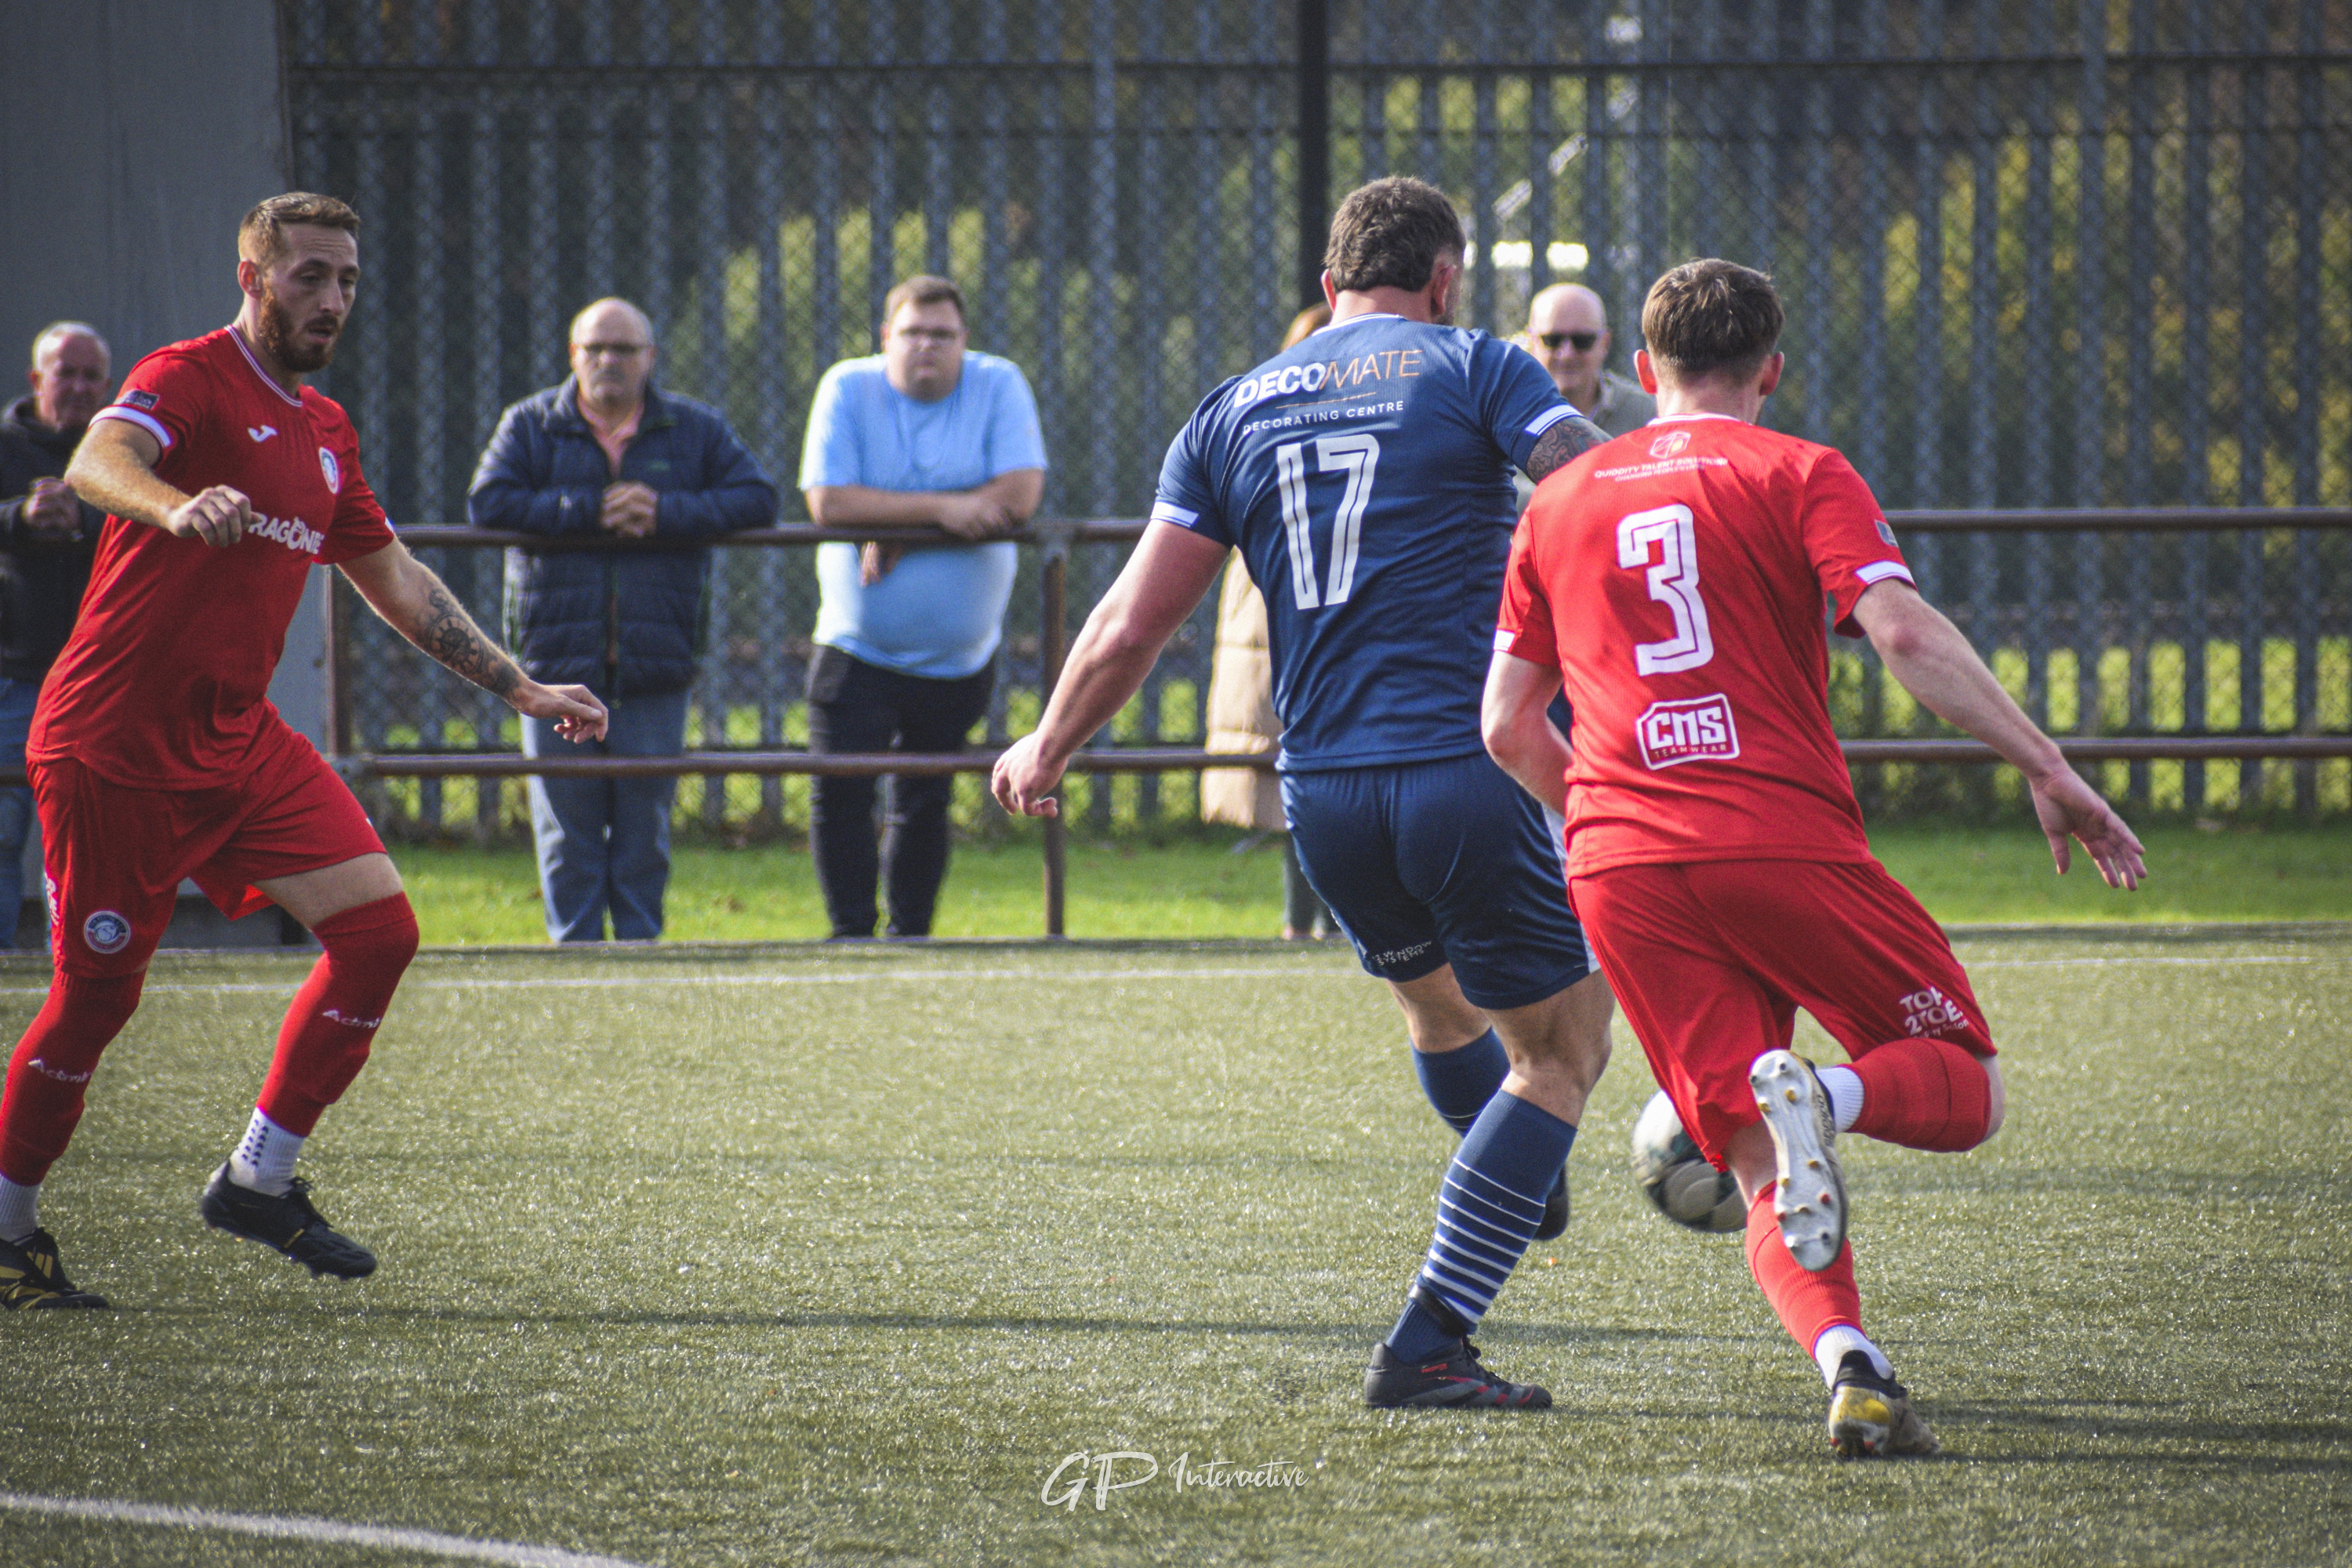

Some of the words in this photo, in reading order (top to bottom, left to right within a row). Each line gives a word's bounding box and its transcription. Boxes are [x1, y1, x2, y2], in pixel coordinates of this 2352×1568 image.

[1243, 410, 1339, 434] DECORATING
[1346, 401, 1404, 417] CENTRE
[1594, 466, 1640, 478] QUIDDITY
[1640, 459, 1675, 471] TALENT
[1276, 434, 1380, 609] 17
[1617, 503, 1714, 677] 3
[1647, 706, 1727, 750] CMS
[1654, 744, 1727, 758] TEAMWEAR
